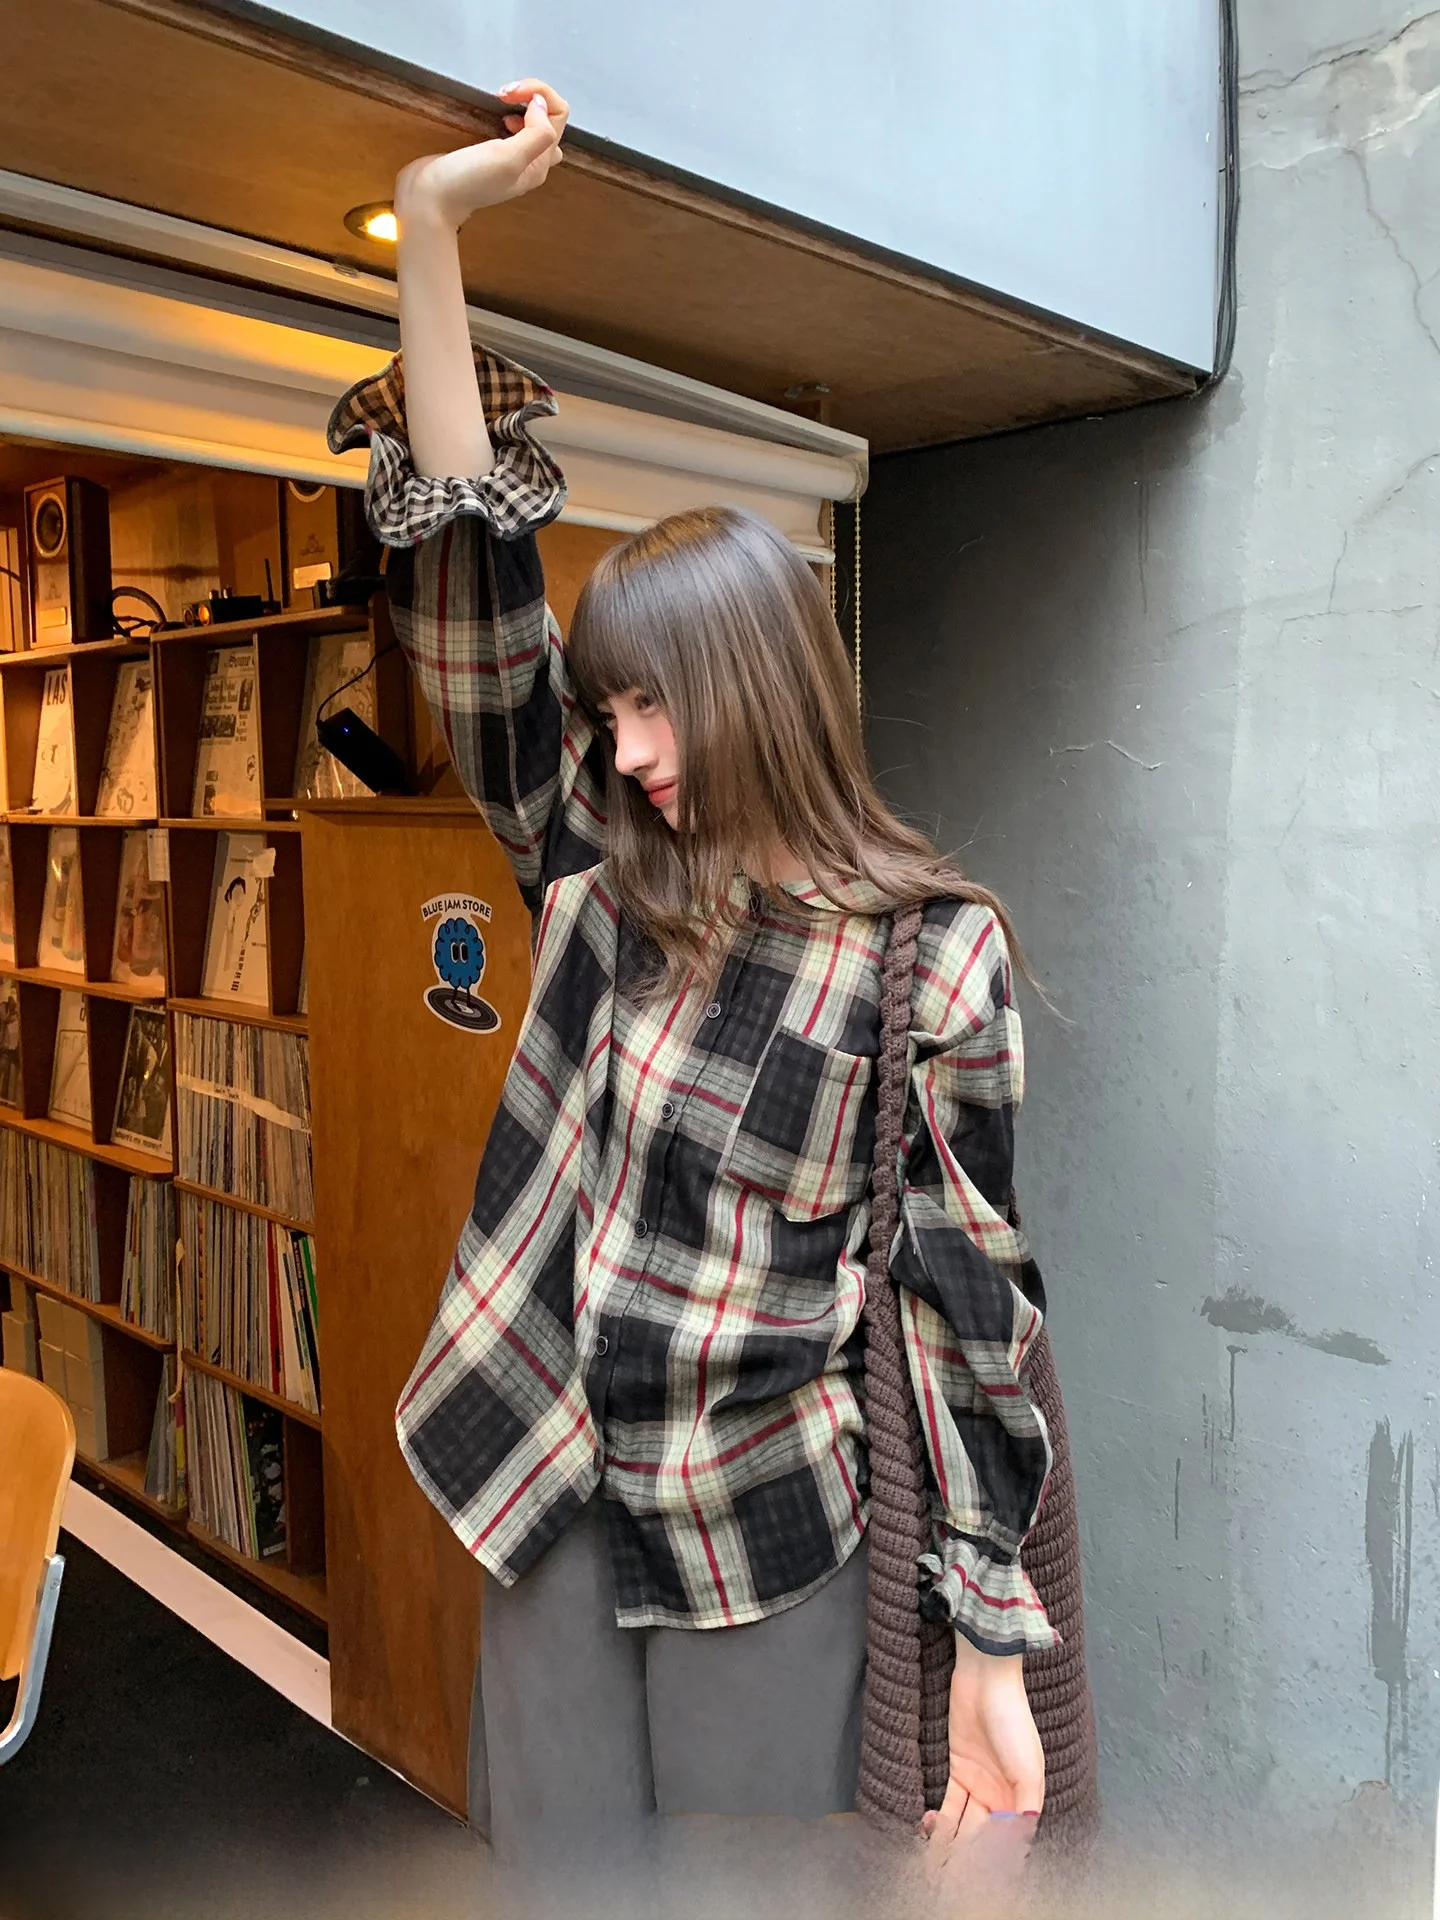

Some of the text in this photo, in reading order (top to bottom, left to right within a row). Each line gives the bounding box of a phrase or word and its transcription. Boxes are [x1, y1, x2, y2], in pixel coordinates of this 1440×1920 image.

[423, 899, 491, 918] BLUE JAM STORE
